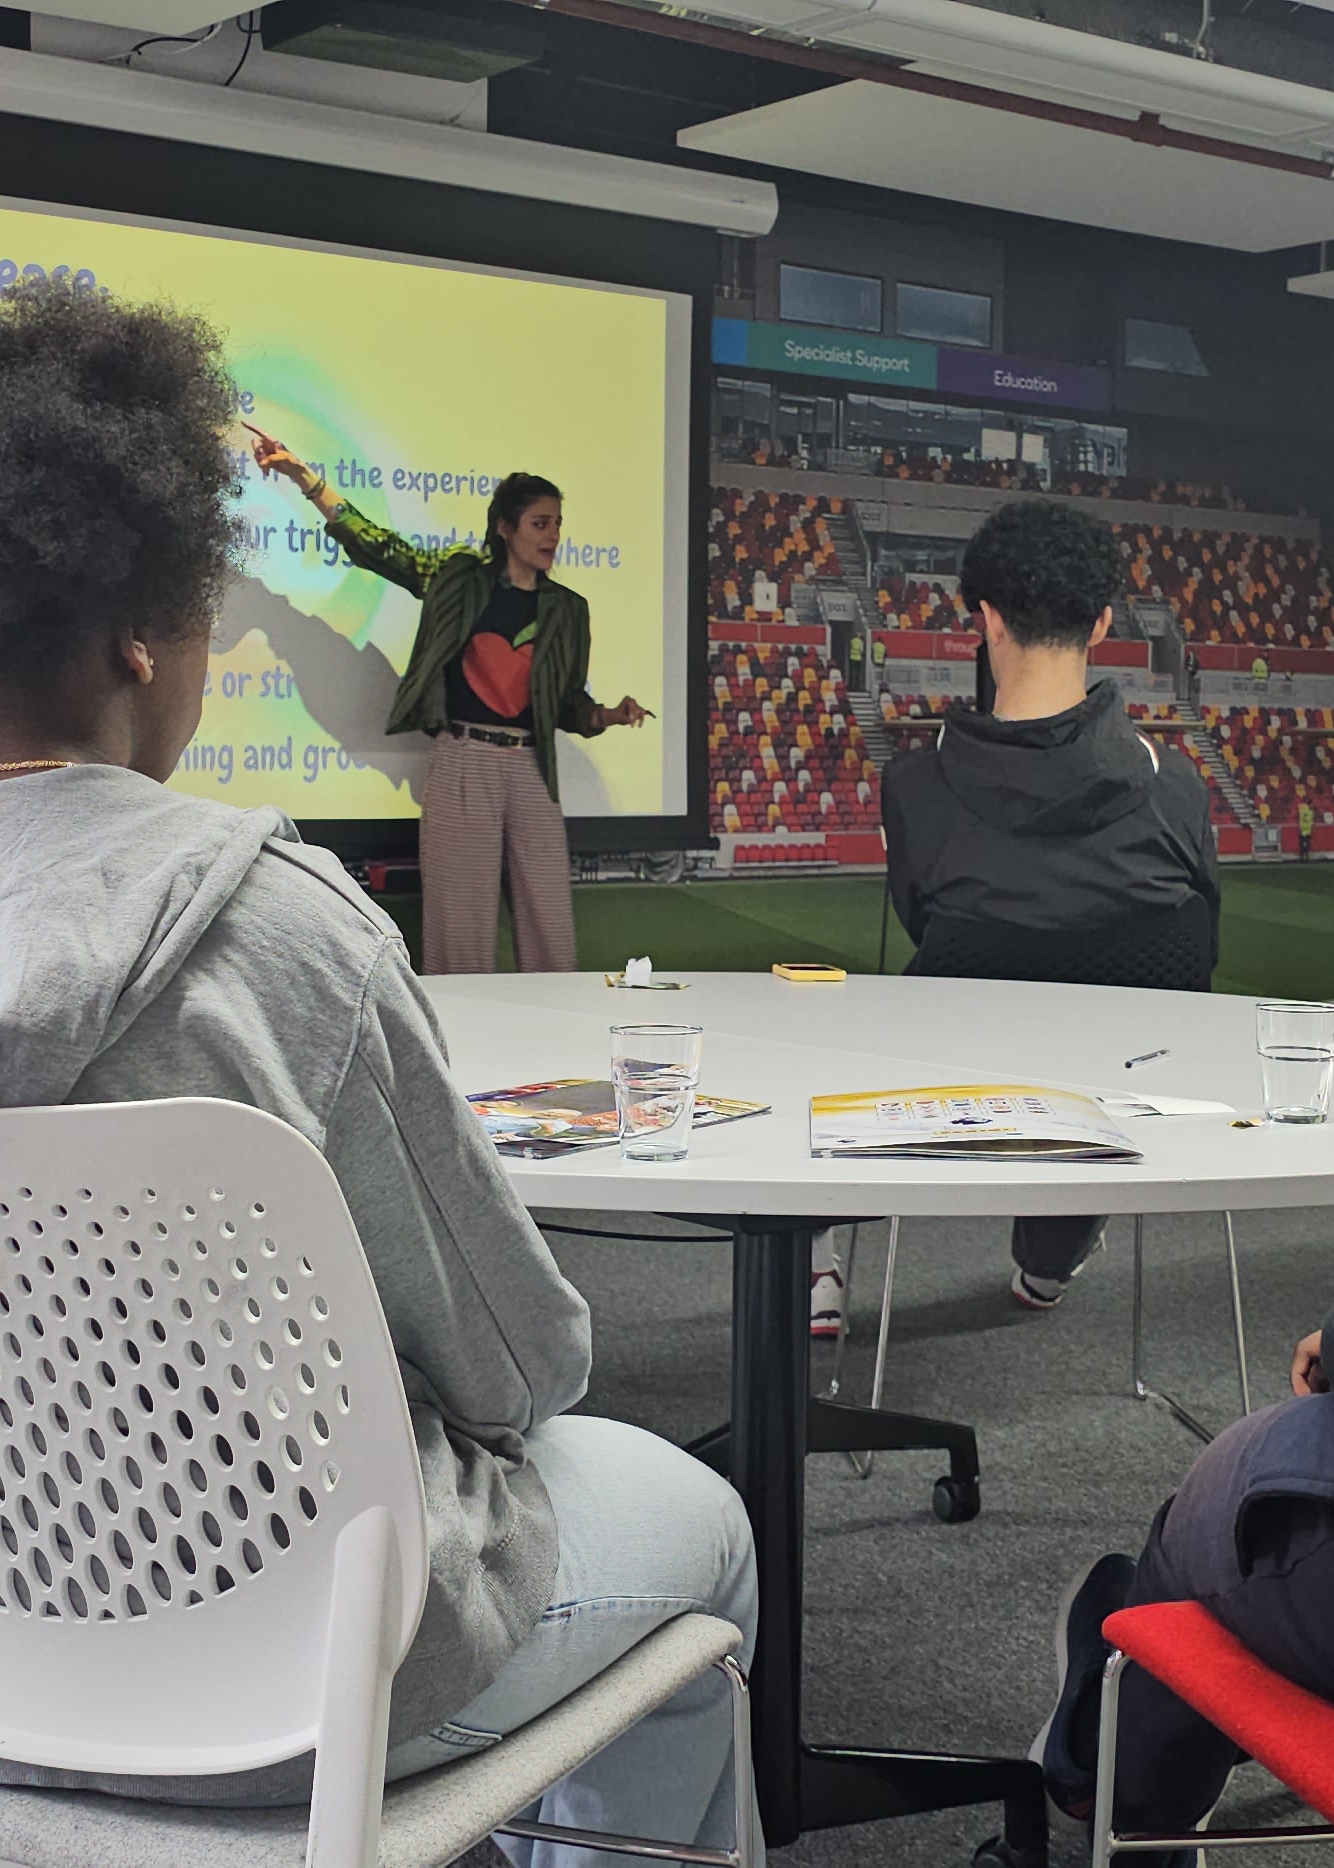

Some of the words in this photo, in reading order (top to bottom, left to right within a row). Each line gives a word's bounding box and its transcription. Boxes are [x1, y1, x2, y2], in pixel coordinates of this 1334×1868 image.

[784, 339, 853, 366] Specialist
[854, 349, 911, 373] Support
[993, 369, 1058, 393] Education
[334, 458, 383, 489] the
[221, 671, 253, 700] or
[243, 735, 293, 772] and
